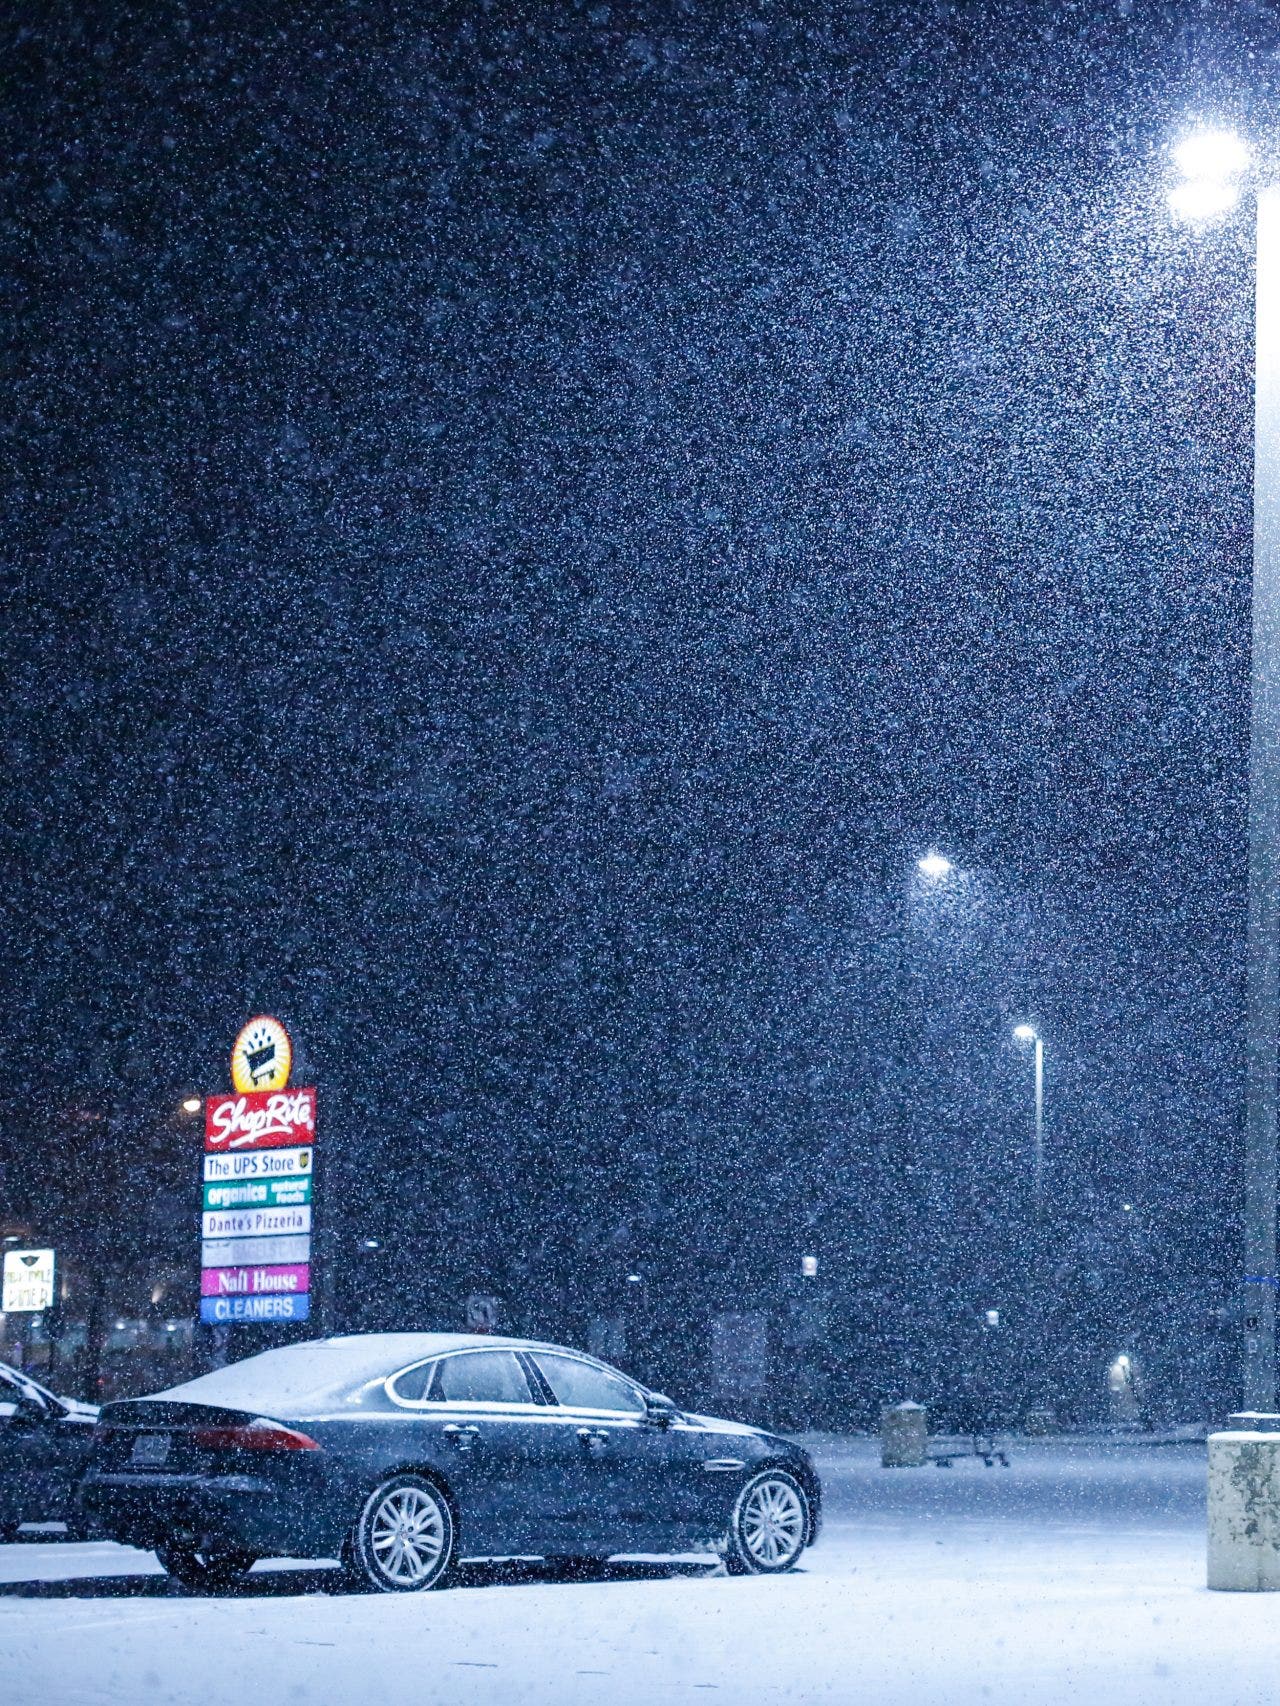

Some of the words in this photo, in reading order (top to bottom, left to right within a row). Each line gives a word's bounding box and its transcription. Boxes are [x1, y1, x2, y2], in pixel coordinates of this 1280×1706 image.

[209, 1092, 313, 1147] ShopRite
[208, 1157, 230, 1175] The
[233, 1154, 258, 1173] UPS
[262, 1151, 294, 1171] Store
[209, 1214, 252, 1232] Dante's
[256, 1211, 303, 1229] Pizzeria
[218, 1272, 248, 1293] Nail
[253, 1269, 298, 1291] House
[215, 1298, 293, 1320] CLEANERS
